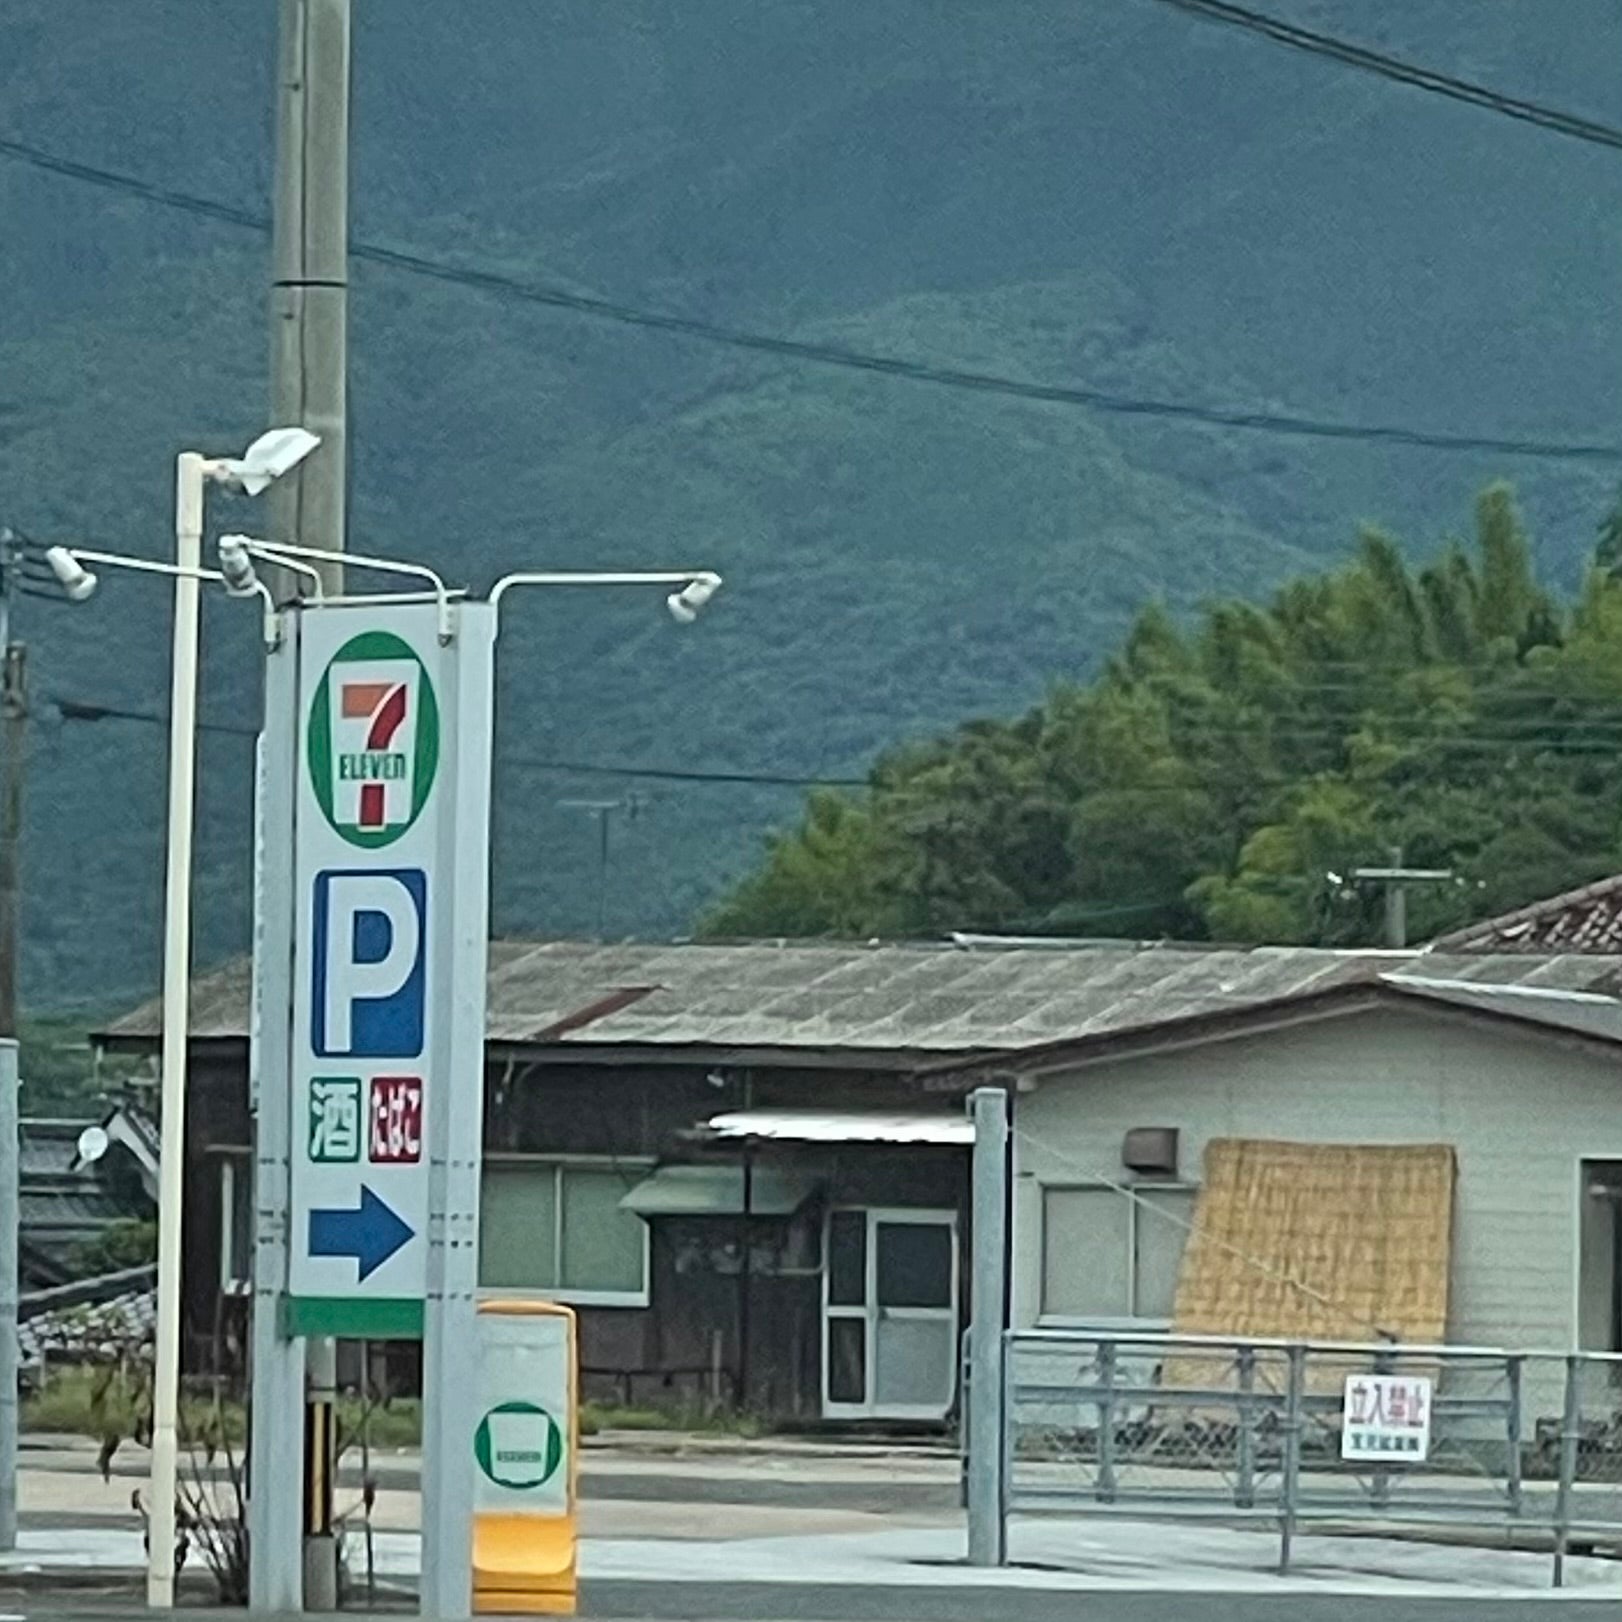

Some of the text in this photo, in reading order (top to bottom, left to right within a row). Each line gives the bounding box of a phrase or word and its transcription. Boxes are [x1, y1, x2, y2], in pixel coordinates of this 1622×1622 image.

[341, 682, 407, 828] 7
[324, 875, 420, 1053] P
[310, 1082, 359, 1158] 酒
[371, 1083, 420, 1157] たばこ
[1349, 1382, 1424, 1428] 立入禁止
